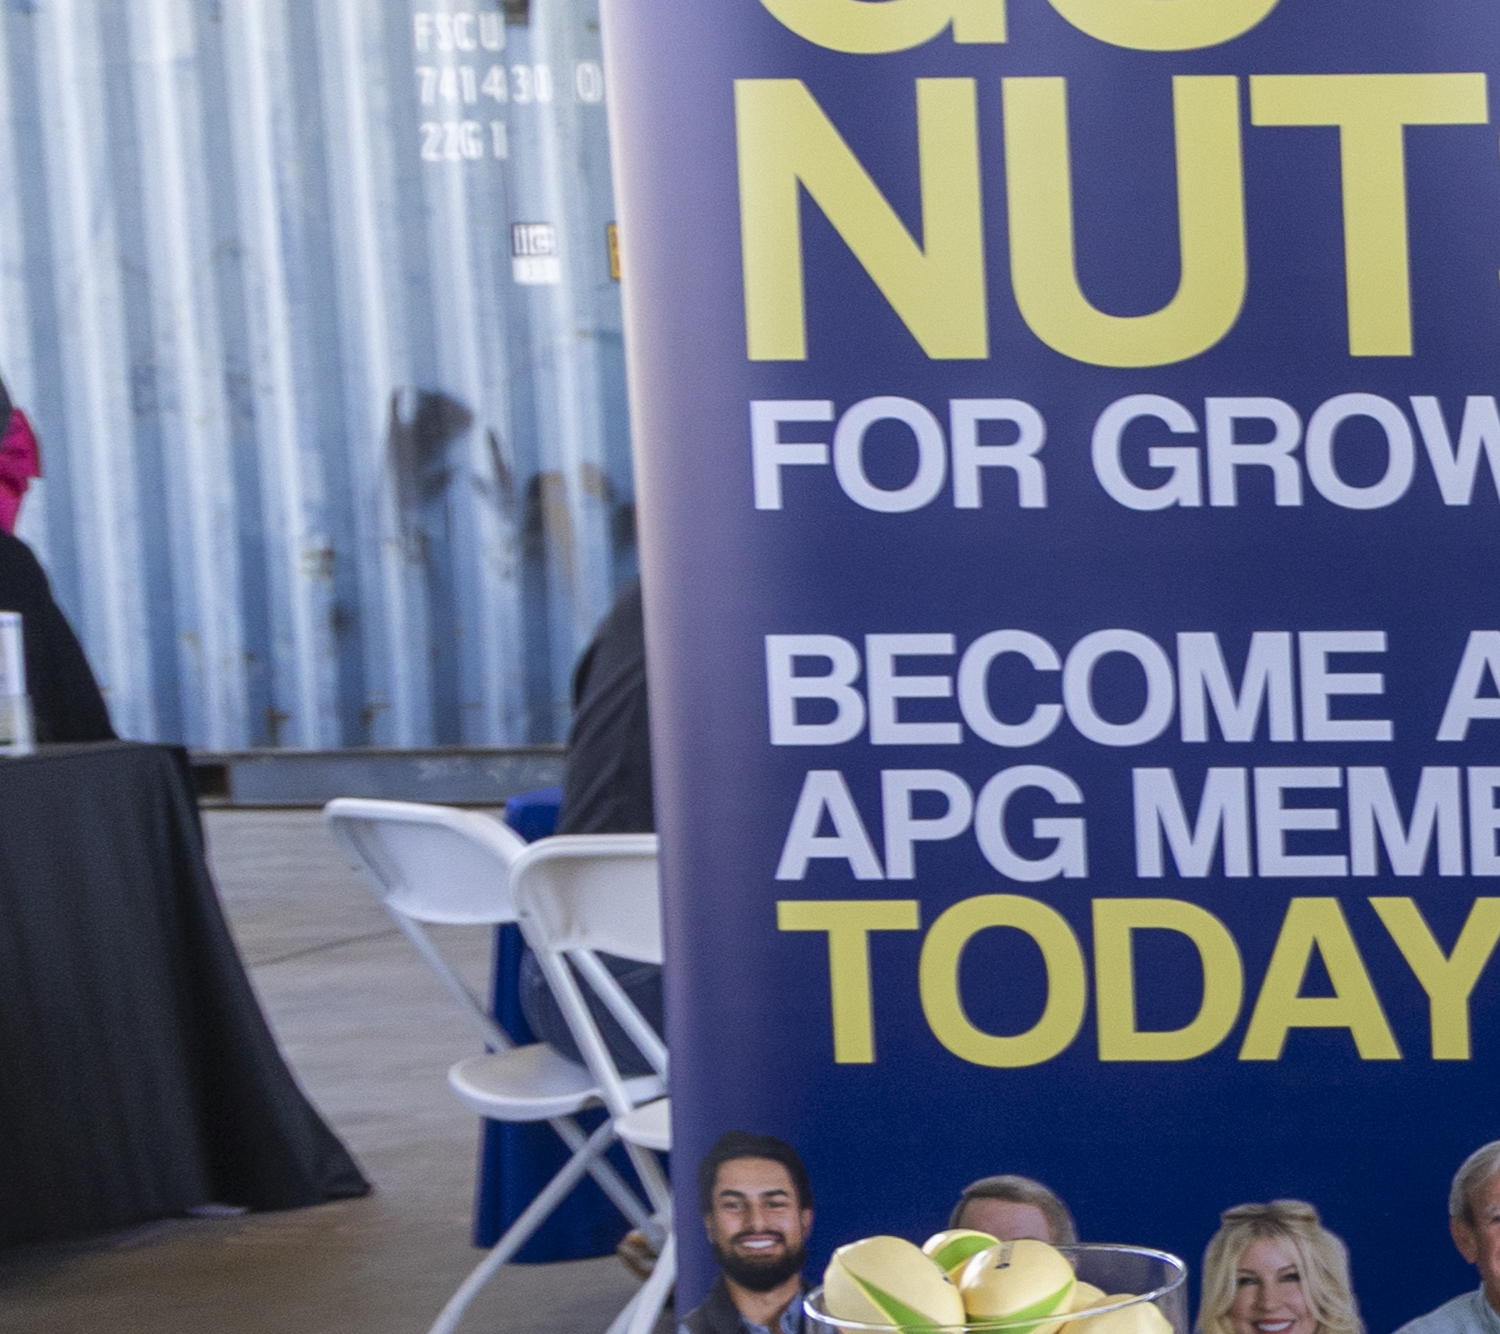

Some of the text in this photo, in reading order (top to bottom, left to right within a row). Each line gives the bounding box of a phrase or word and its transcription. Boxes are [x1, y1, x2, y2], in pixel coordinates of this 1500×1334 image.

[750, 397, 1047, 512] FOR
[764, 629, 1393, 747] BECOME
[775, 765, 1087, 884] APG
